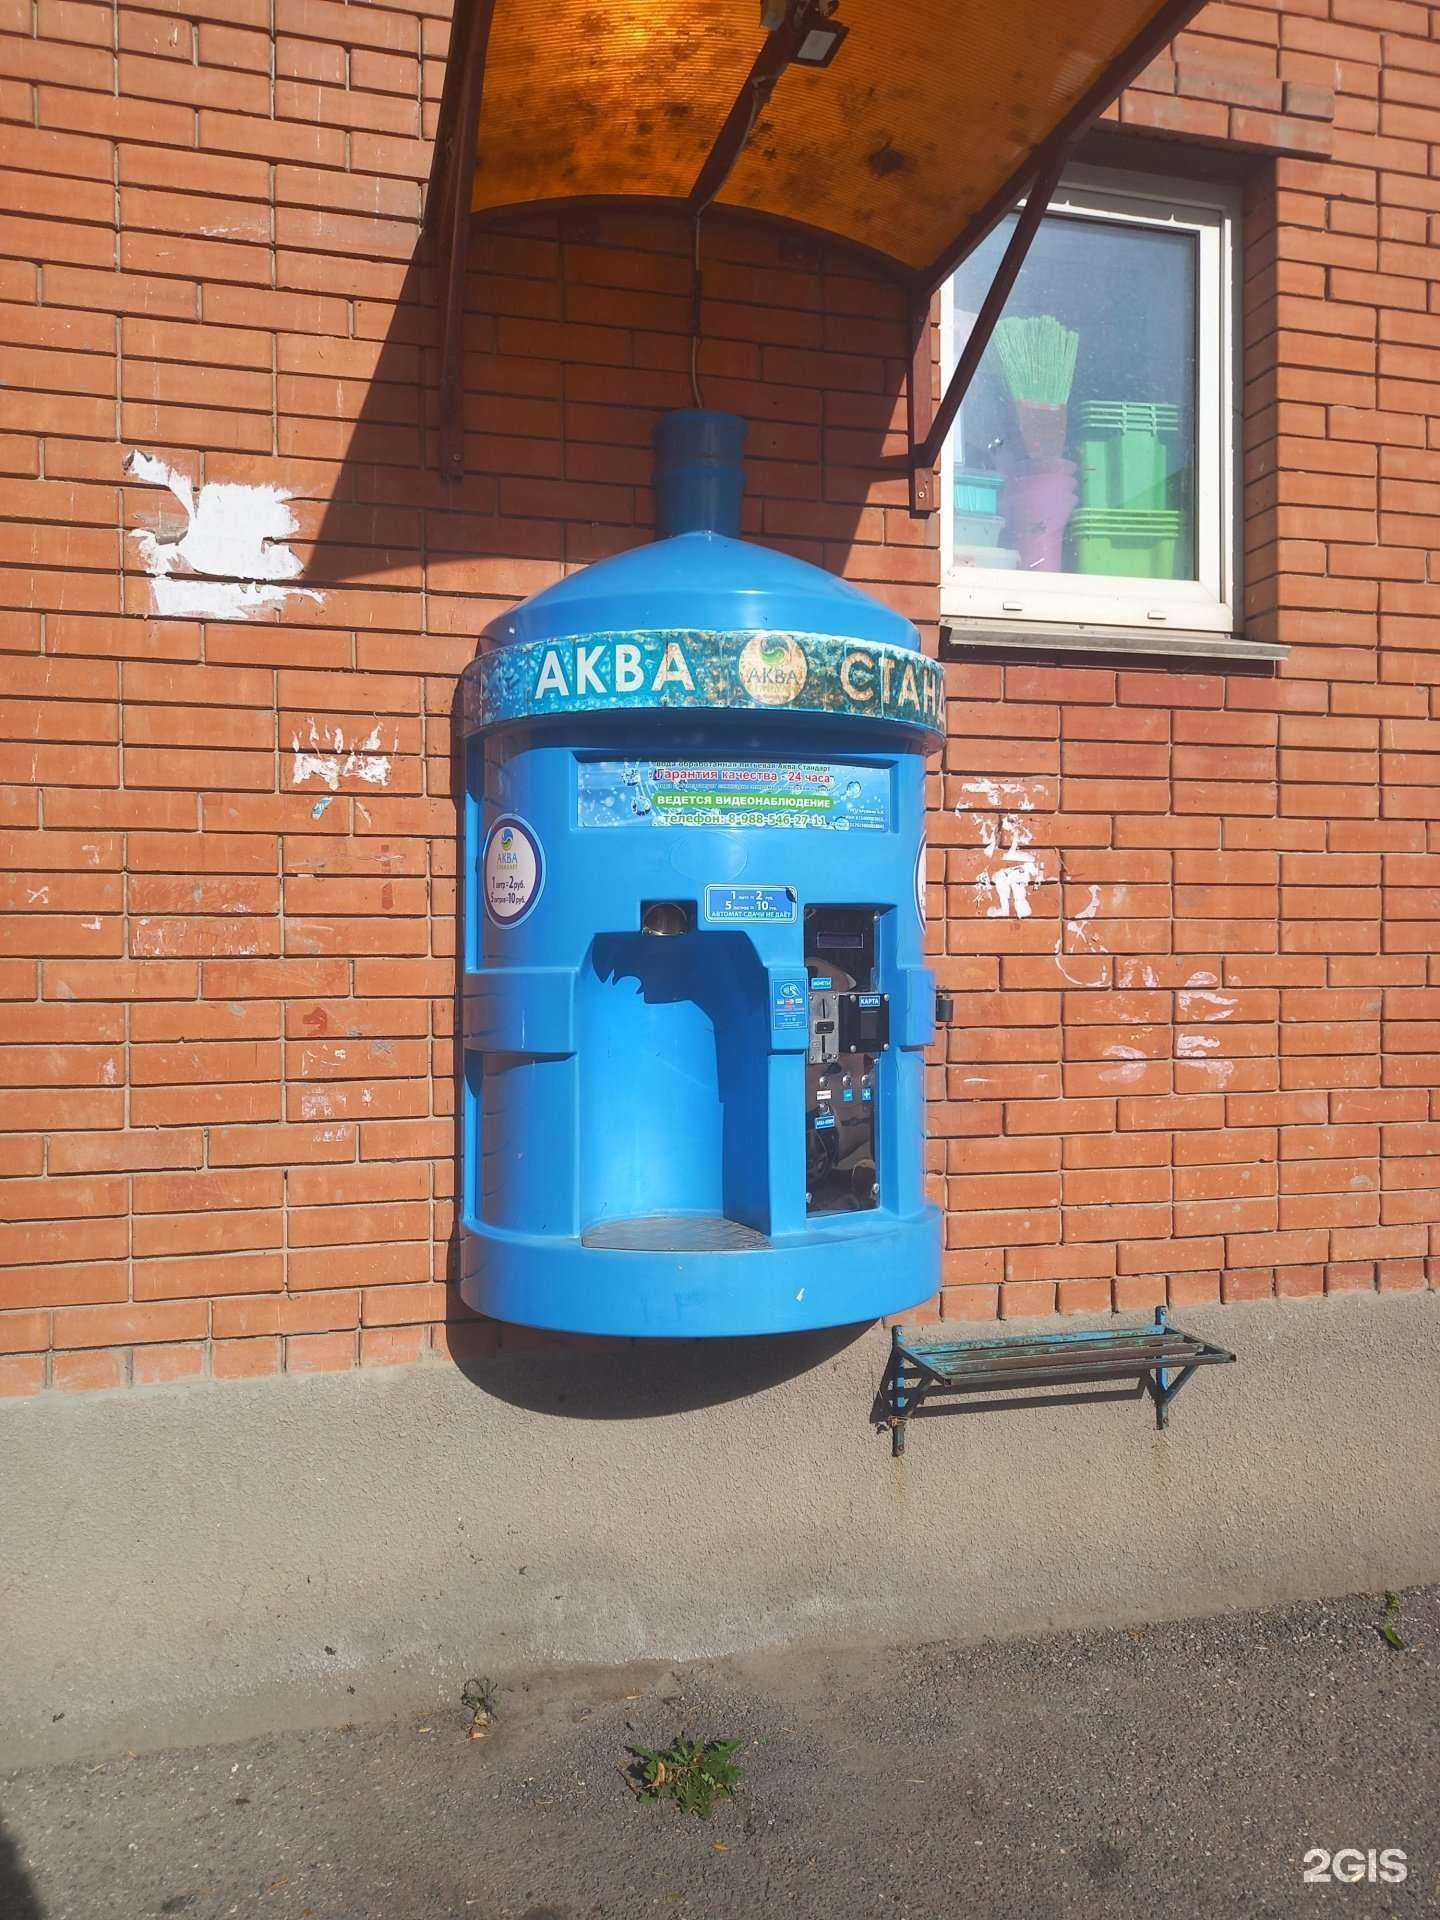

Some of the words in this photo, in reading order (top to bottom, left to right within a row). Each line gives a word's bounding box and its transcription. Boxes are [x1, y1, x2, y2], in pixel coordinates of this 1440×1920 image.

[534, 642, 696, 699] АКВА
[747, 668, 799, 685] АКВА
[656, 768, 718, 783] Гарантия
[722, 770, 777, 782] качества
[788, 771, 802, 782] 24
[805, 774, 830, 783] часа
[657, 795, 712, 806] ВЕДЕТСЯ
[716, 796, 831, 809] ВИДЕОНАБЛЮДЕНИЕ
[664, 812, 724, 825] телефон:
[497, 853, 518, 864] АКВА
[755, 890, 763, 900] 2
[725, 900, 732, 910] 5
[756, 901, 769, 911] 10
